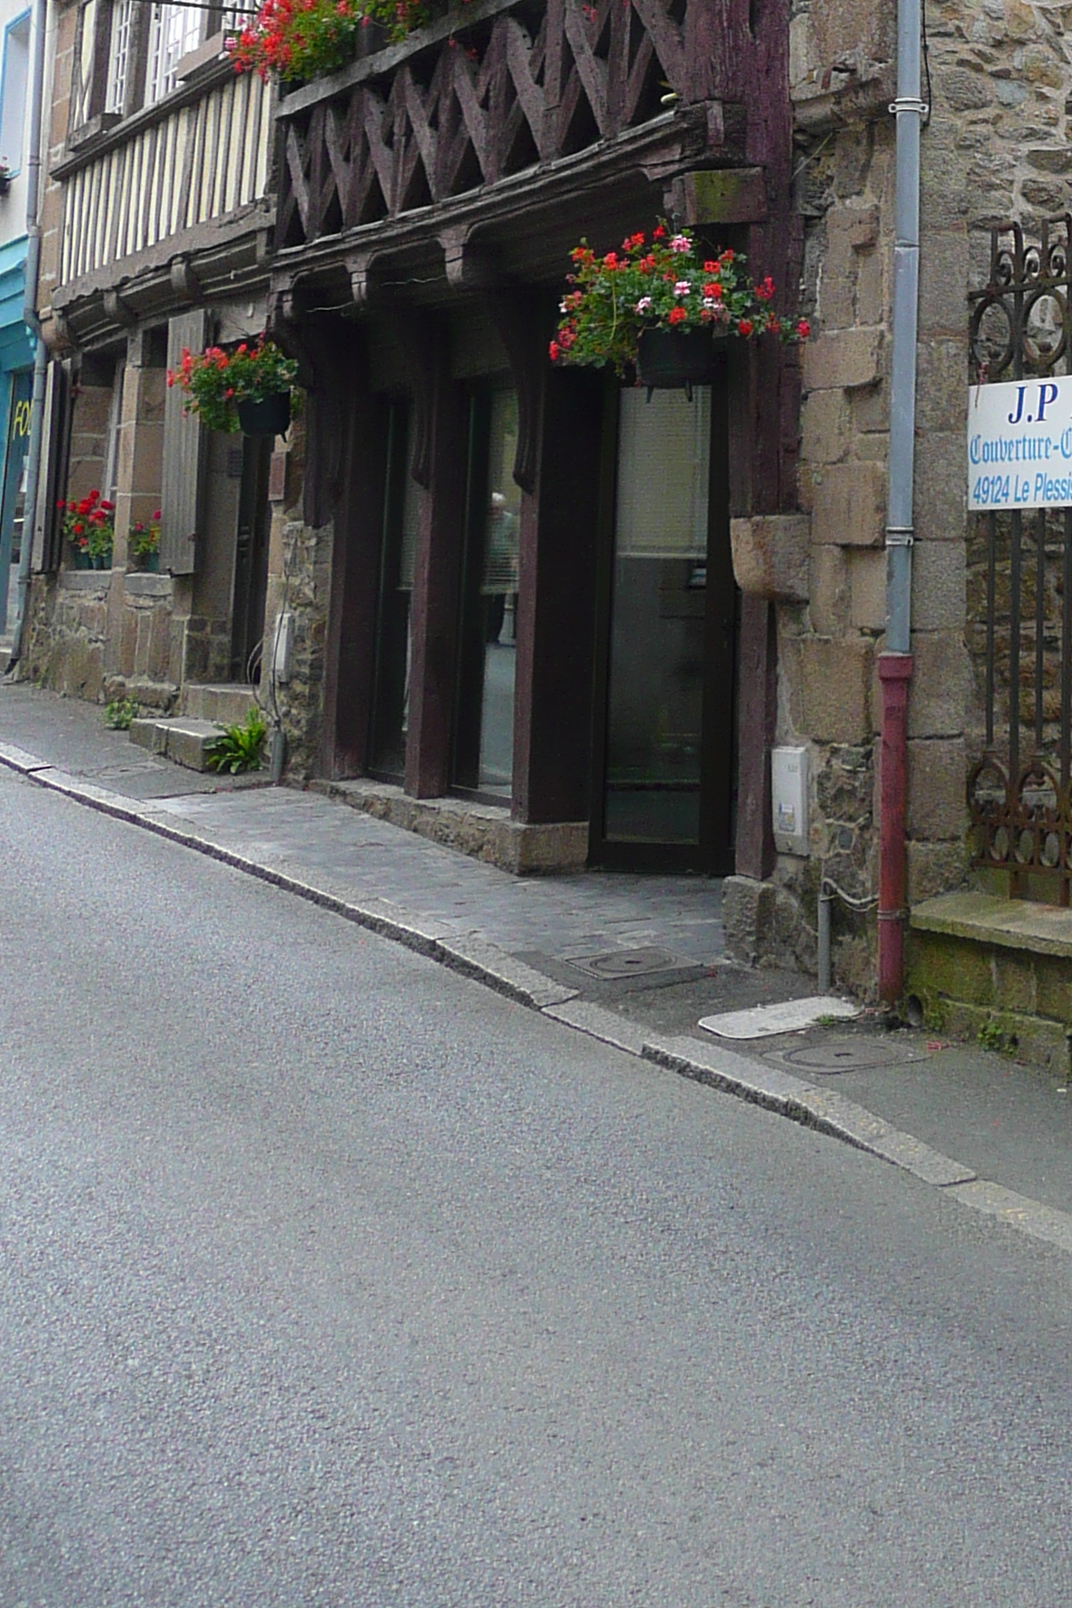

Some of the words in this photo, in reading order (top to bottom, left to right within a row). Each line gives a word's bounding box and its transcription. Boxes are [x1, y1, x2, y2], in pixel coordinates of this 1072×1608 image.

[12, 400, 32, 440] FO
[973, 474, 1011, 505] 49124
[1013, 474, 1030, 503] Le
